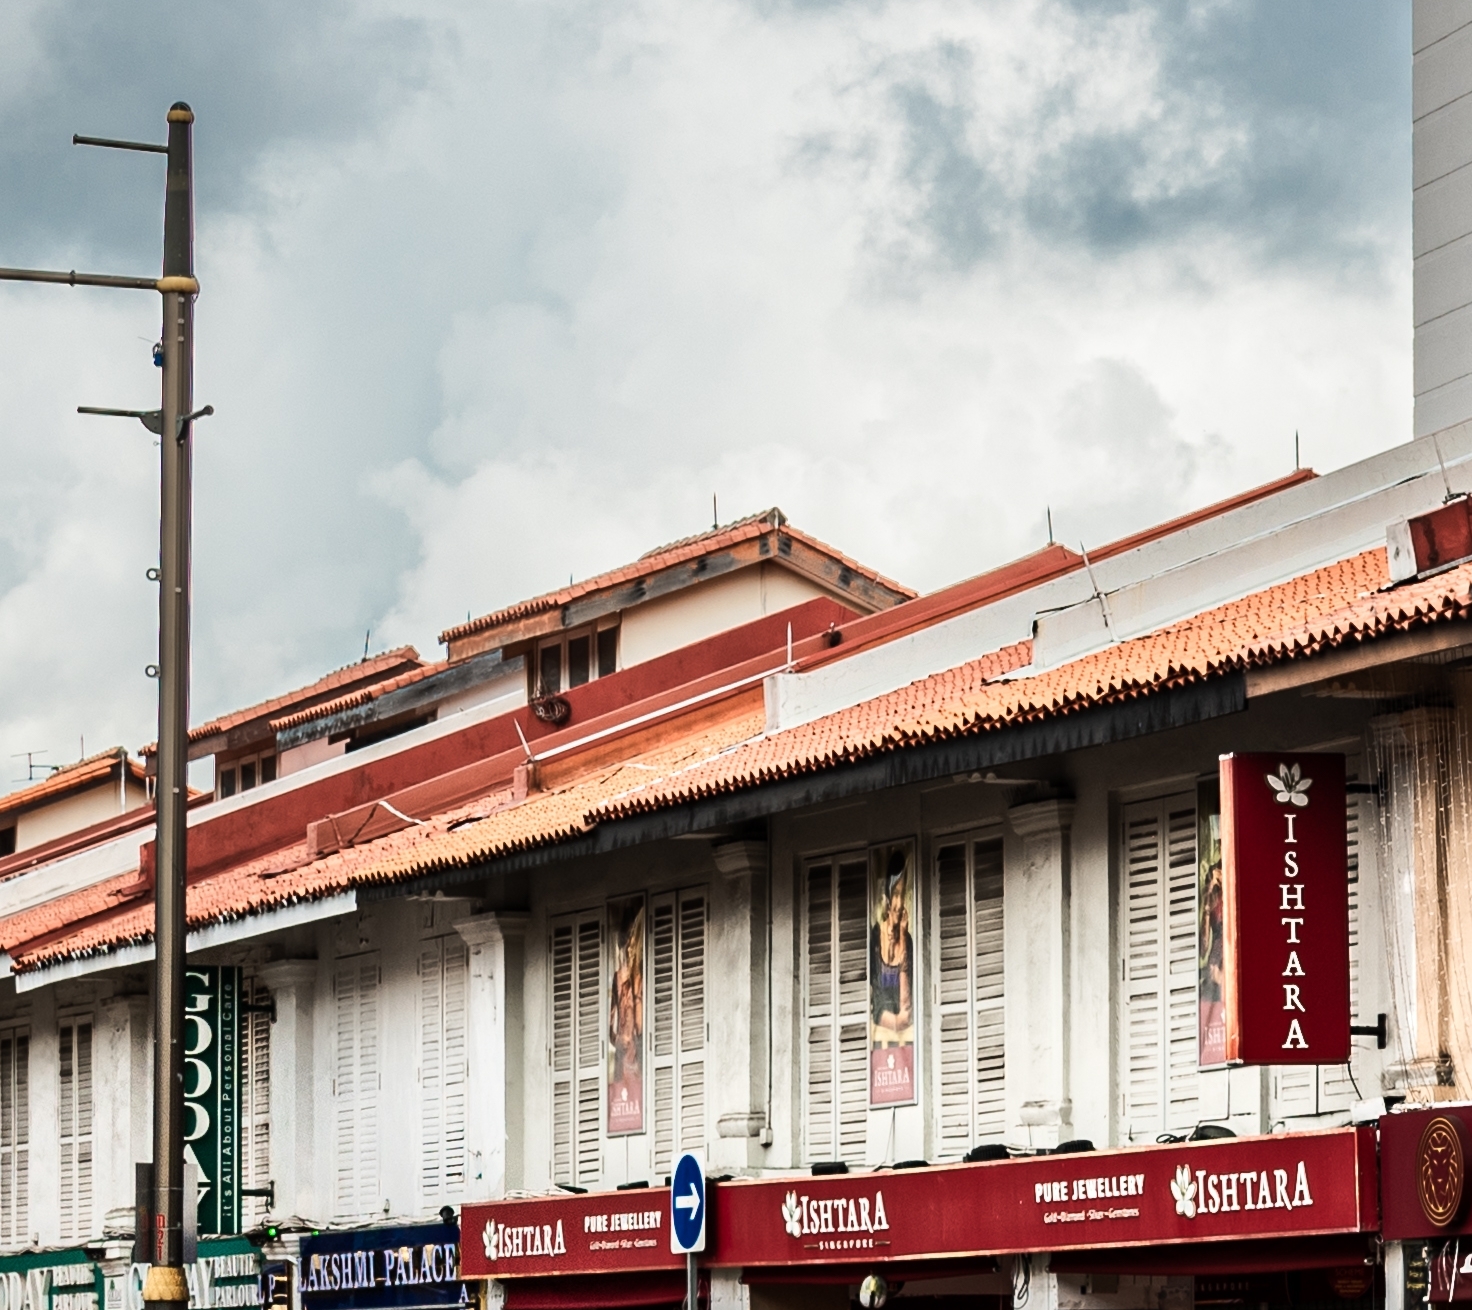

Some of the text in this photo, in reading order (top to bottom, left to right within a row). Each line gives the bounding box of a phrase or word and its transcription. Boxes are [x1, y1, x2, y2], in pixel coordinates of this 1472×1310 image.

[1279, 814, 1308, 1049] ISHTARA
[222, 984, 232, 1022] Care
[222, 1027, 232, 1101] Personal
[874, 1066, 910, 1087] ISHTARA
[222, 1117, 232, 1157] About
[222, 1160, 232, 1184] All
[1035, 1173, 1145, 1203] PURE JEWELLERY
[1196, 1161, 1313, 1214] ISHTARA
[584, 1210, 662, 1234] PURE JEWELLERY
[800, 1191, 889, 1235] ISHTARA
[497, 1219, 568, 1259] ISHTARA
[297, 1244, 457, 1292] LAKSHMI PALACE
